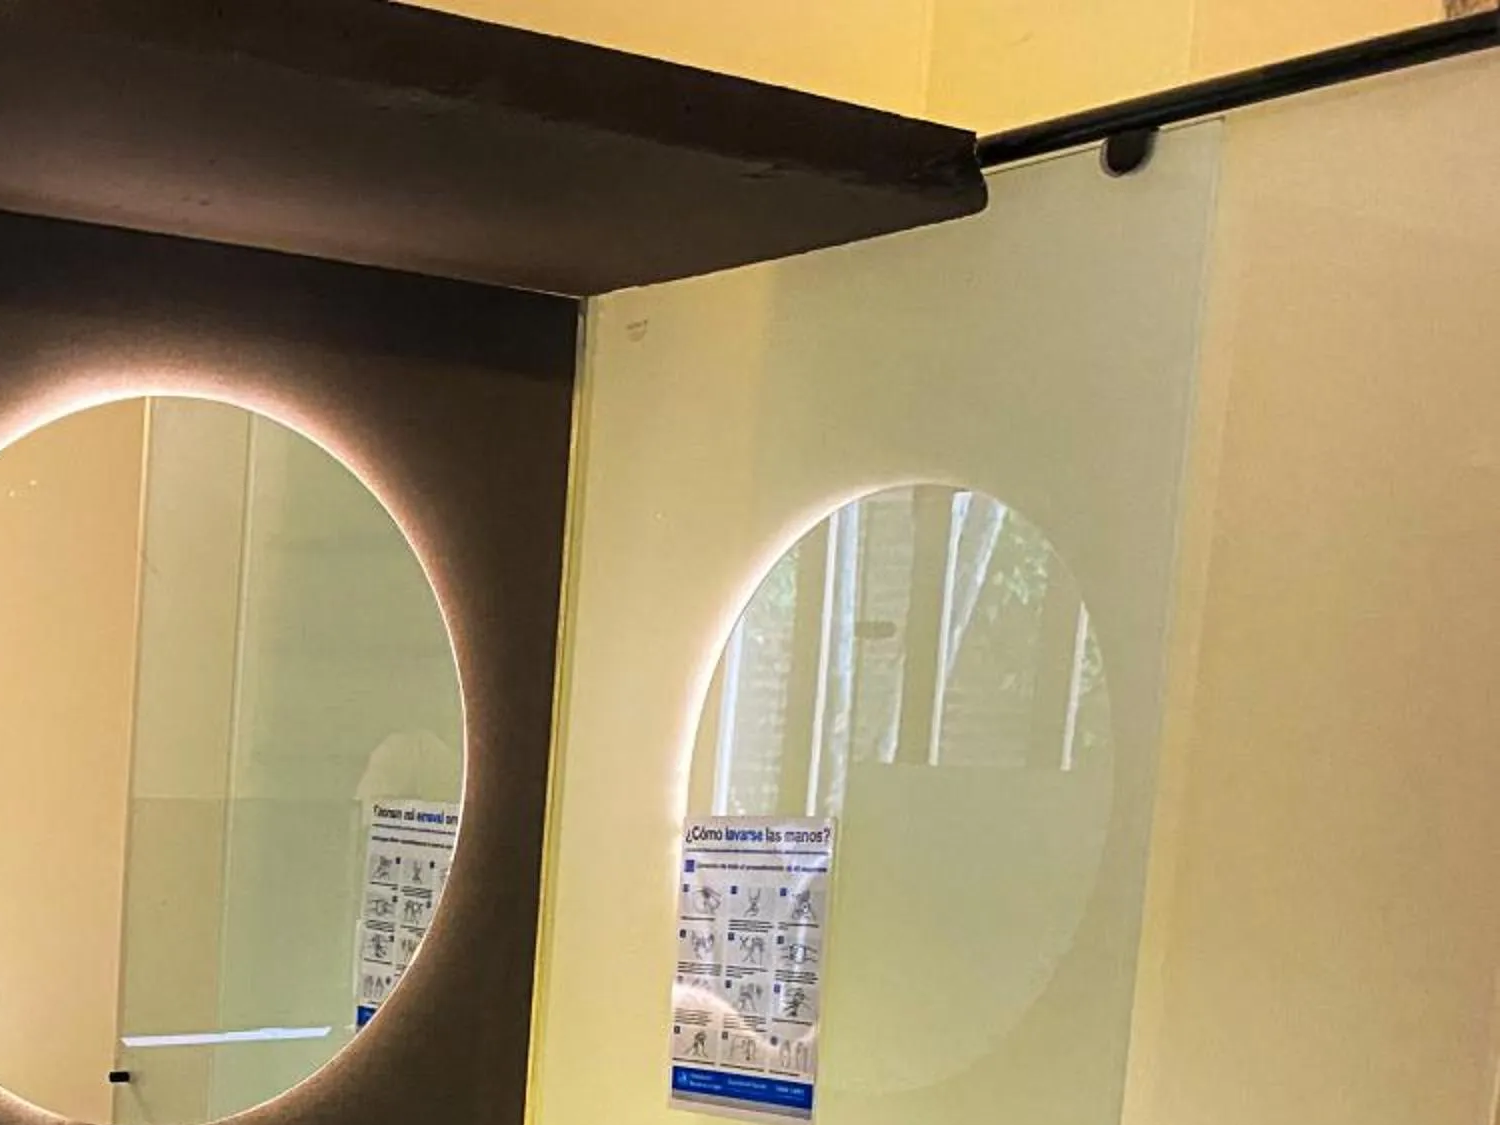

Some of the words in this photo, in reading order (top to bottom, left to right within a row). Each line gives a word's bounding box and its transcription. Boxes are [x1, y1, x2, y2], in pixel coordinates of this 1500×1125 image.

[685, 826, 723, 843] ¿Cómo
[725, 826, 763, 841] lavarse
[765, 827, 782, 842] las
[784, 828, 831, 843] manos?
